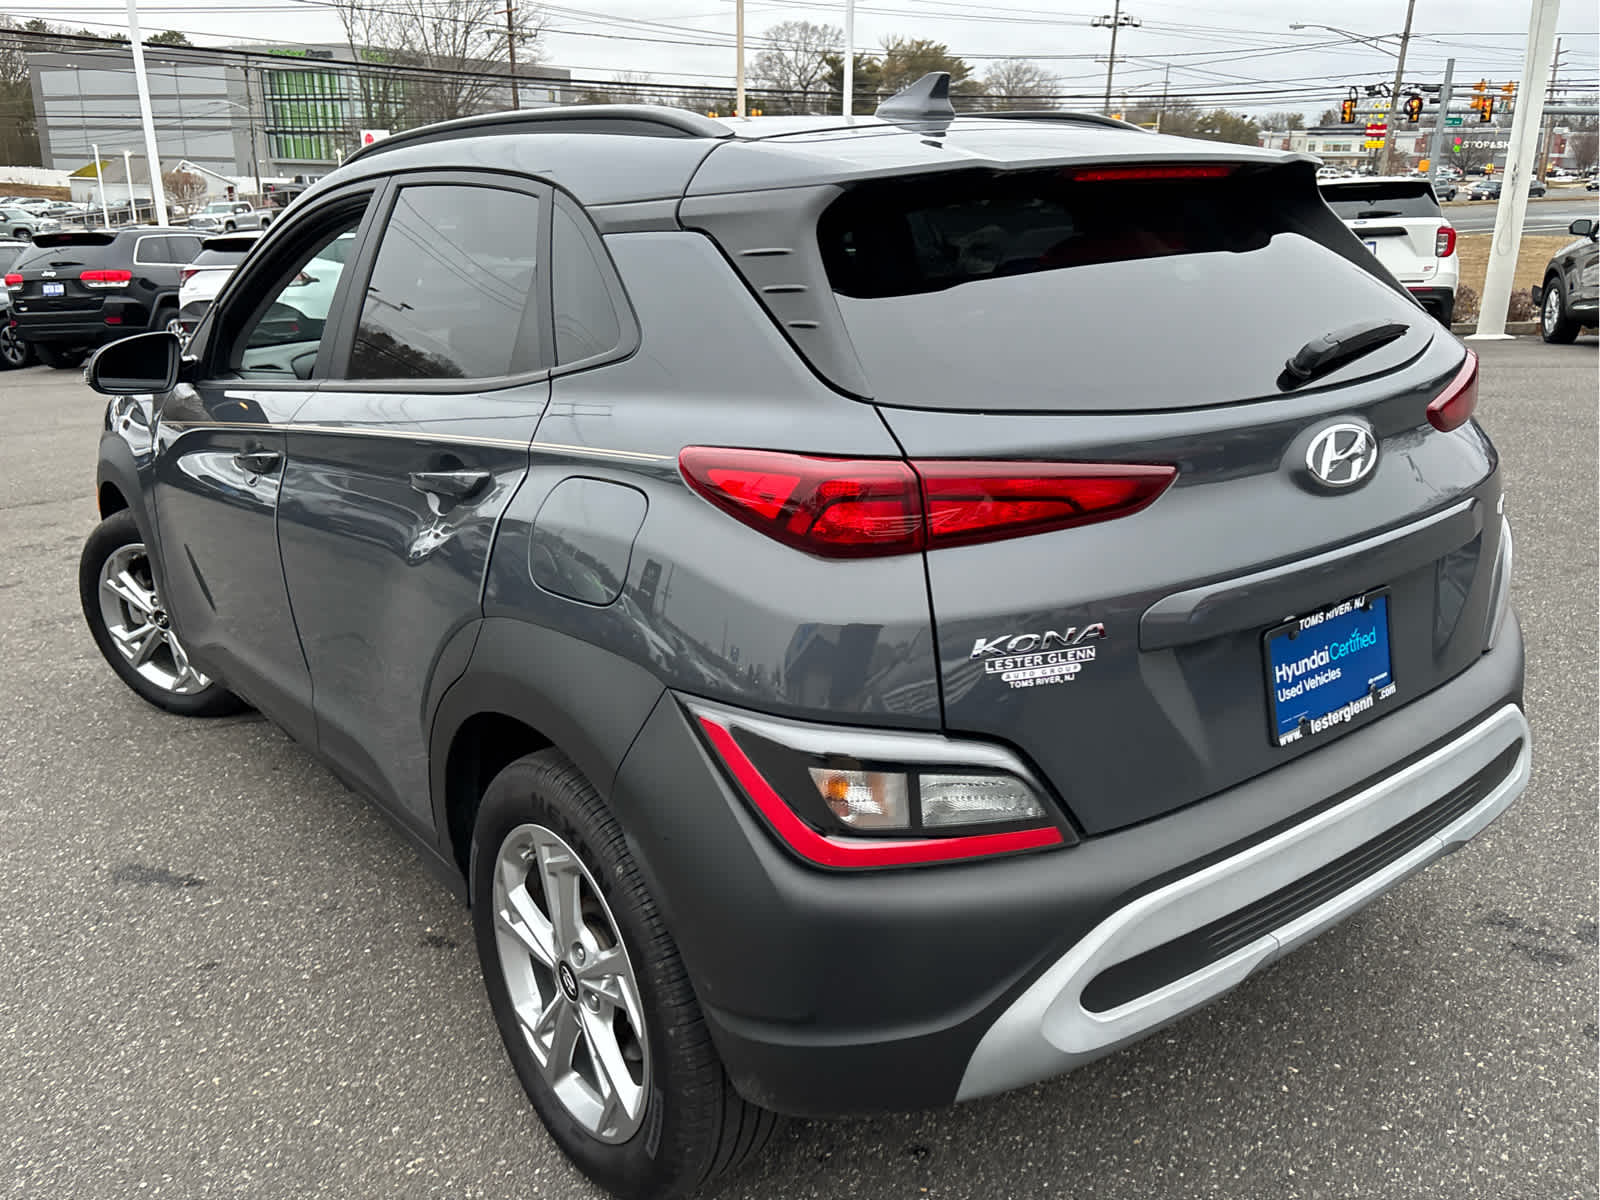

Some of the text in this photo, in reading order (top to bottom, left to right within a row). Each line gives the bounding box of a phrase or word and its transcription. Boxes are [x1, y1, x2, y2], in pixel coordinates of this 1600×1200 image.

[1299, 611, 1325, 631] TOMS
[1353, 596, 1366, 610] NJ
[970, 622, 1107, 659] KONA
[985, 647, 1097, 672] LESTER GLENN
[1004, 664, 1079, 680] AUTO GROUP
[1009, 679, 1035, 689] TOMS
[1064, 673, 1075, 681] NJ
[1277, 681, 1303, 702] Used
[1303, 667, 1342, 691] Vehicles
